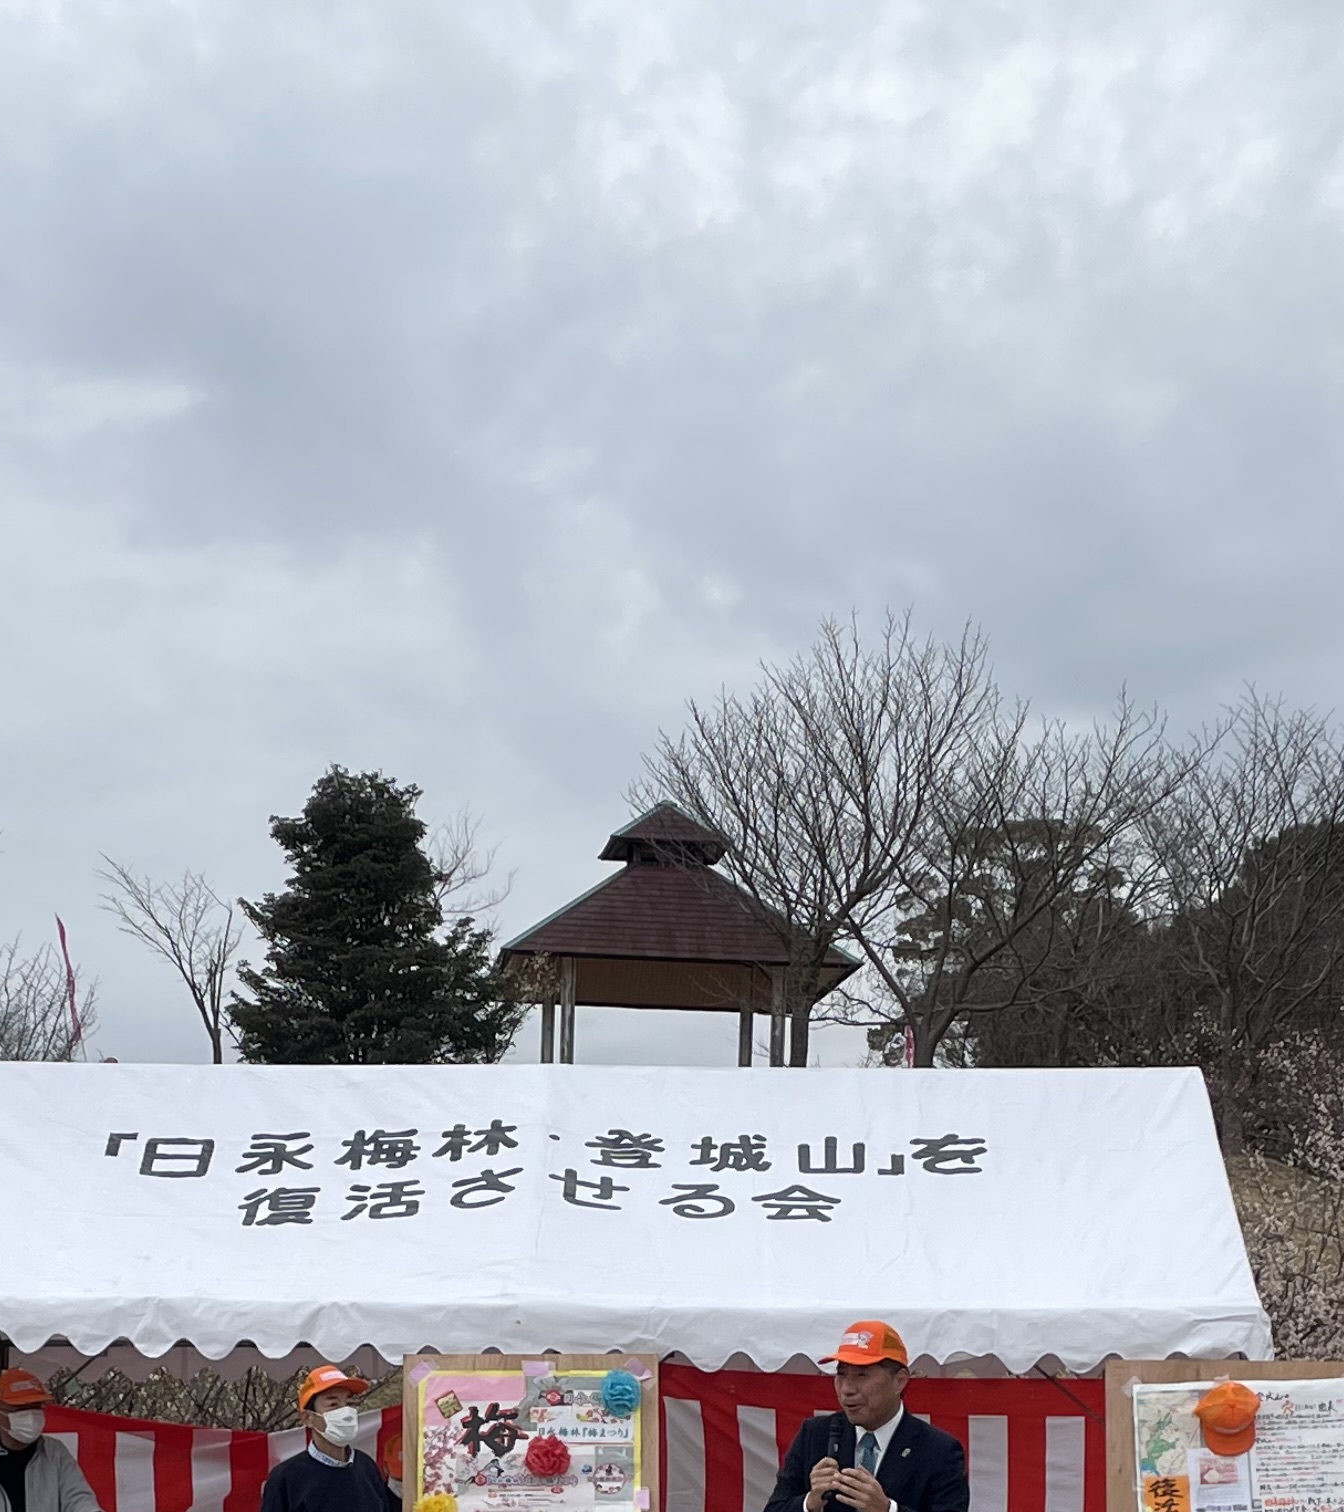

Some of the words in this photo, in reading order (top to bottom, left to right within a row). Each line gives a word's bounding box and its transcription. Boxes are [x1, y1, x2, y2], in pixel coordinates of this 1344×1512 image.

[103, 1118, 989, 1179] 「日永梅林・登城山」を
[237, 1166, 842, 1227] 復活させる会
[454, 1402, 529, 1458] 梅
